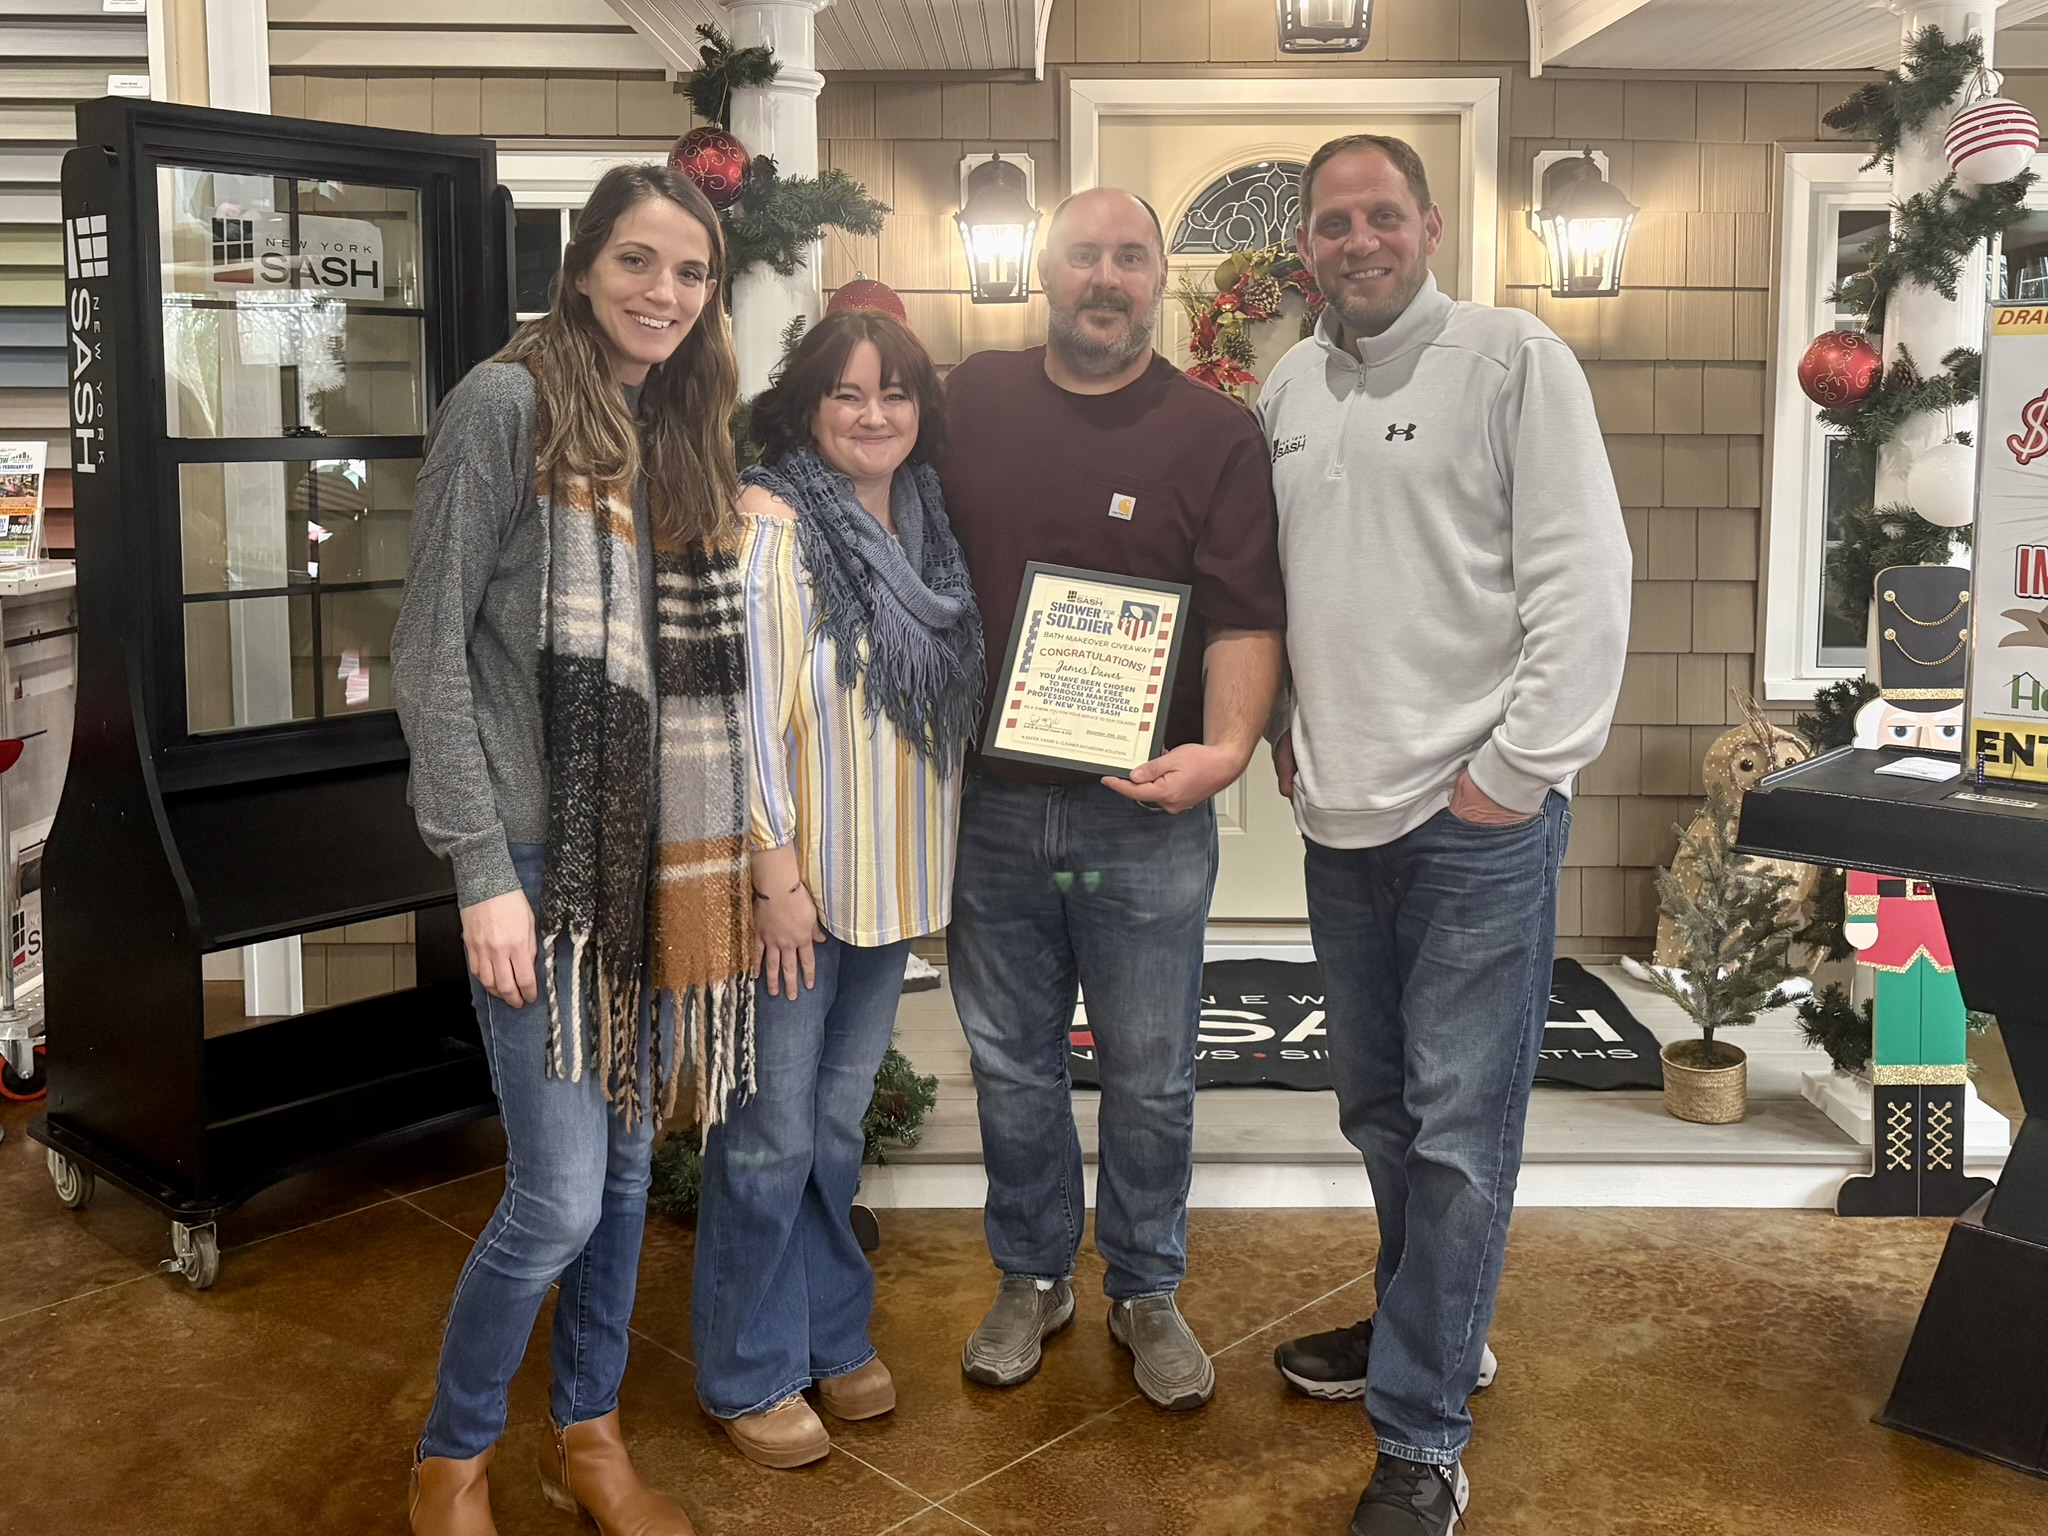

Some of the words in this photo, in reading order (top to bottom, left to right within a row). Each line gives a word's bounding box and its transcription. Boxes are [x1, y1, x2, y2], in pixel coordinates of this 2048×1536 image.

[266, 238, 307, 249] NEW
[321, 242, 372, 254] YORK
[260, 252, 379, 289] SASH
[1997, 309, 2048, 325] DRA
[92, 296, 102, 360] NEW
[71, 287, 96, 474] SASH
[95, 381, 105, 464] YORK
[1277, 438, 1307, 458] SASH
[1050, 601, 1102, 619] SHOWER
[1076, 596, 1104, 607] SASH
[1046, 612, 1114, 636] SOLDIER
[1043, 631, 1065, 640] BATH
[1065, 635, 1110, 648] MAKEOVER
[1110, 642, 1153, 654] GIVEAWAY
[1039, 648, 1147, 673] CONGRATULATIONS!
[1055, 660, 1089, 674] James
[1039, 672, 1057, 680] YOU
[1057, 675, 1079, 684] HAVE
[1080, 678, 1102, 687] BEEN
[1103, 682, 1136, 693] CHOSEN
[1061, 682, 1094, 693] RECEIVE
[1103, 689, 1124, 698] FREE
[1027, 689, 1096, 706] PROFESSIONALLY
[1097, 701, 1140, 714] INSTALLED
[1039, 685, 1084, 698] BATHROOM
[1085, 693, 1131, 705] MAKEOVER
[1042, 698, 1054, 706] BY
[1055, 700, 1075, 709] NEW
[1076, 704, 1098, 714] YORK
[1099, 708, 1121, 718] SASH
[1538, 1048, 1639, 1060] THS
